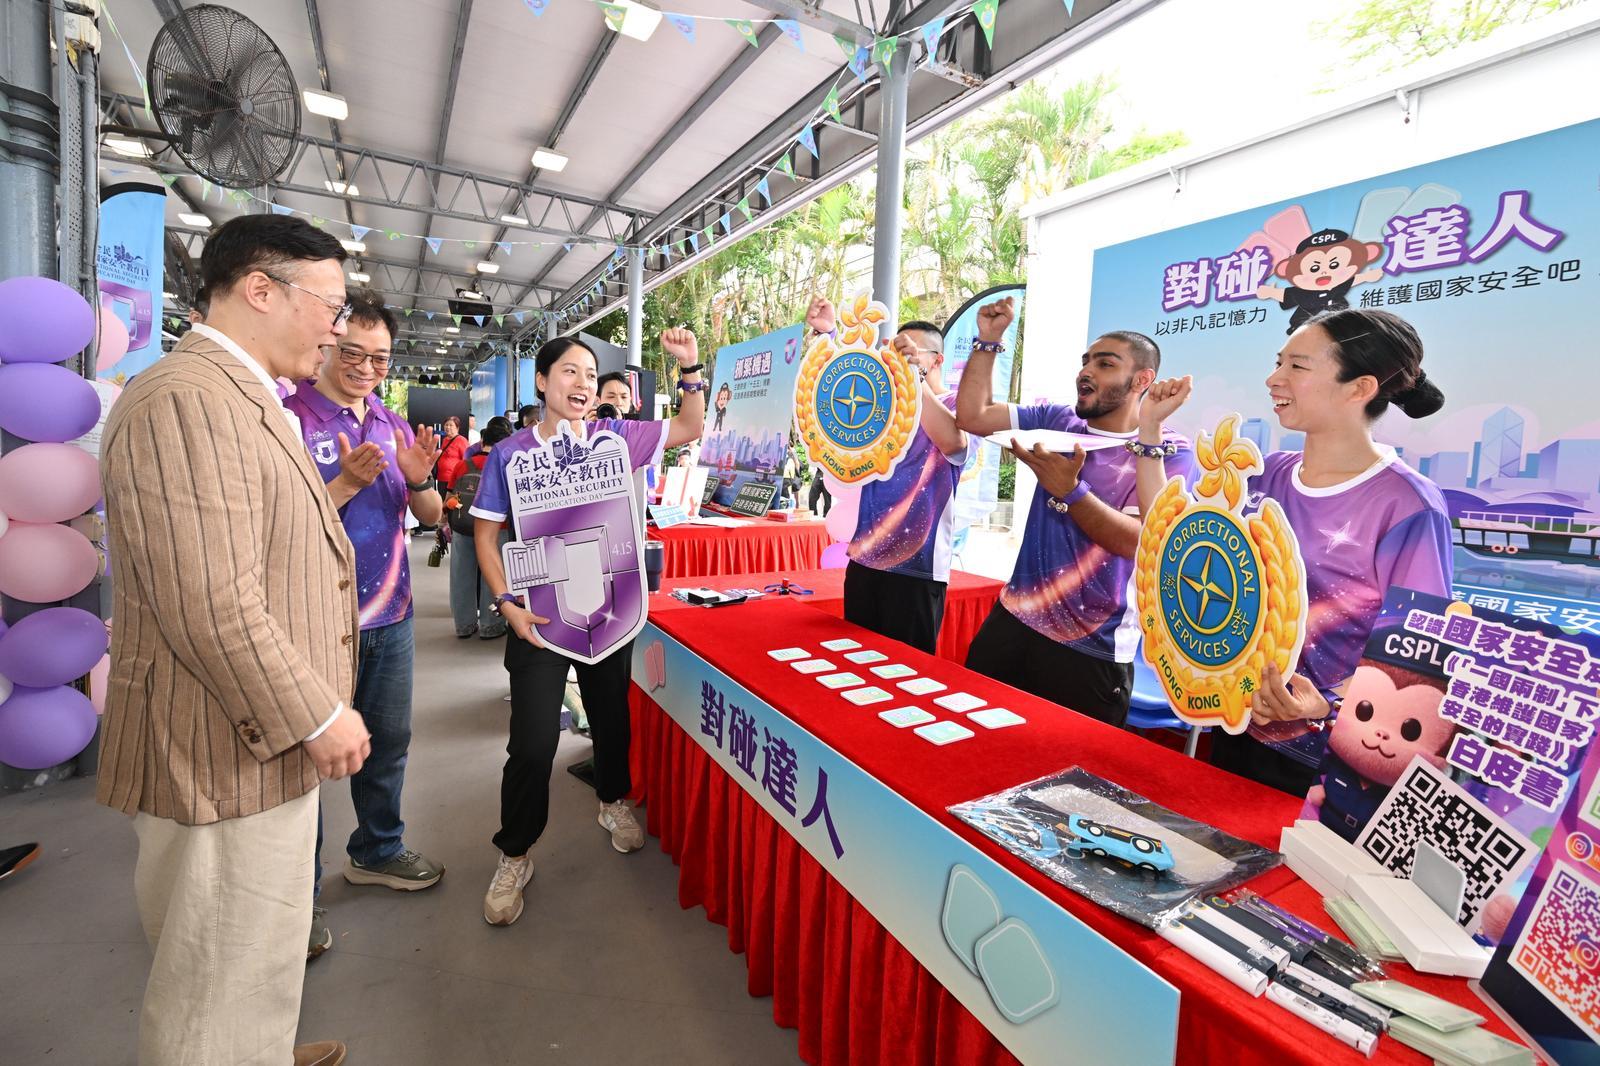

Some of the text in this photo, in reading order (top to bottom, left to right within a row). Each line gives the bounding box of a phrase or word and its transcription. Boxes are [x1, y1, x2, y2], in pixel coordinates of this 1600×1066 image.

[1162, 190, 1566, 313] 對碰 達人
[1311, 233, 1337, 245] CSPL
[1359, 259, 1581, 309] 維護國家安全吧
[1154, 306, 1268, 337] 以非凡記憶力
[821, 357, 888, 398] CORRECTIONAL
[827, 421, 877, 443] SERVICES
[513, 451, 551, 477] 全民
[514, 457, 624, 495] 國家安全教育日
[822, 452, 875, 478] HONG KONG
[520, 477, 624, 505] NATIONAL SECURITY
[544, 492, 604, 510] EDUCATION DAY
[611, 541, 633, 556] 4.15
[1168, 518, 1255, 598] CORRECTIONAL
[1169, 609, 1231, 658] SERVICES
[1384, 633, 1442, 667] CSPL
[1158, 653, 1221, 710] HONG KONG
[1450, 679, 1589, 743] 香港維護國家
[700, 679, 845, 861] 對碰達人
[1453, 736, 1564, 809] 白皮書
